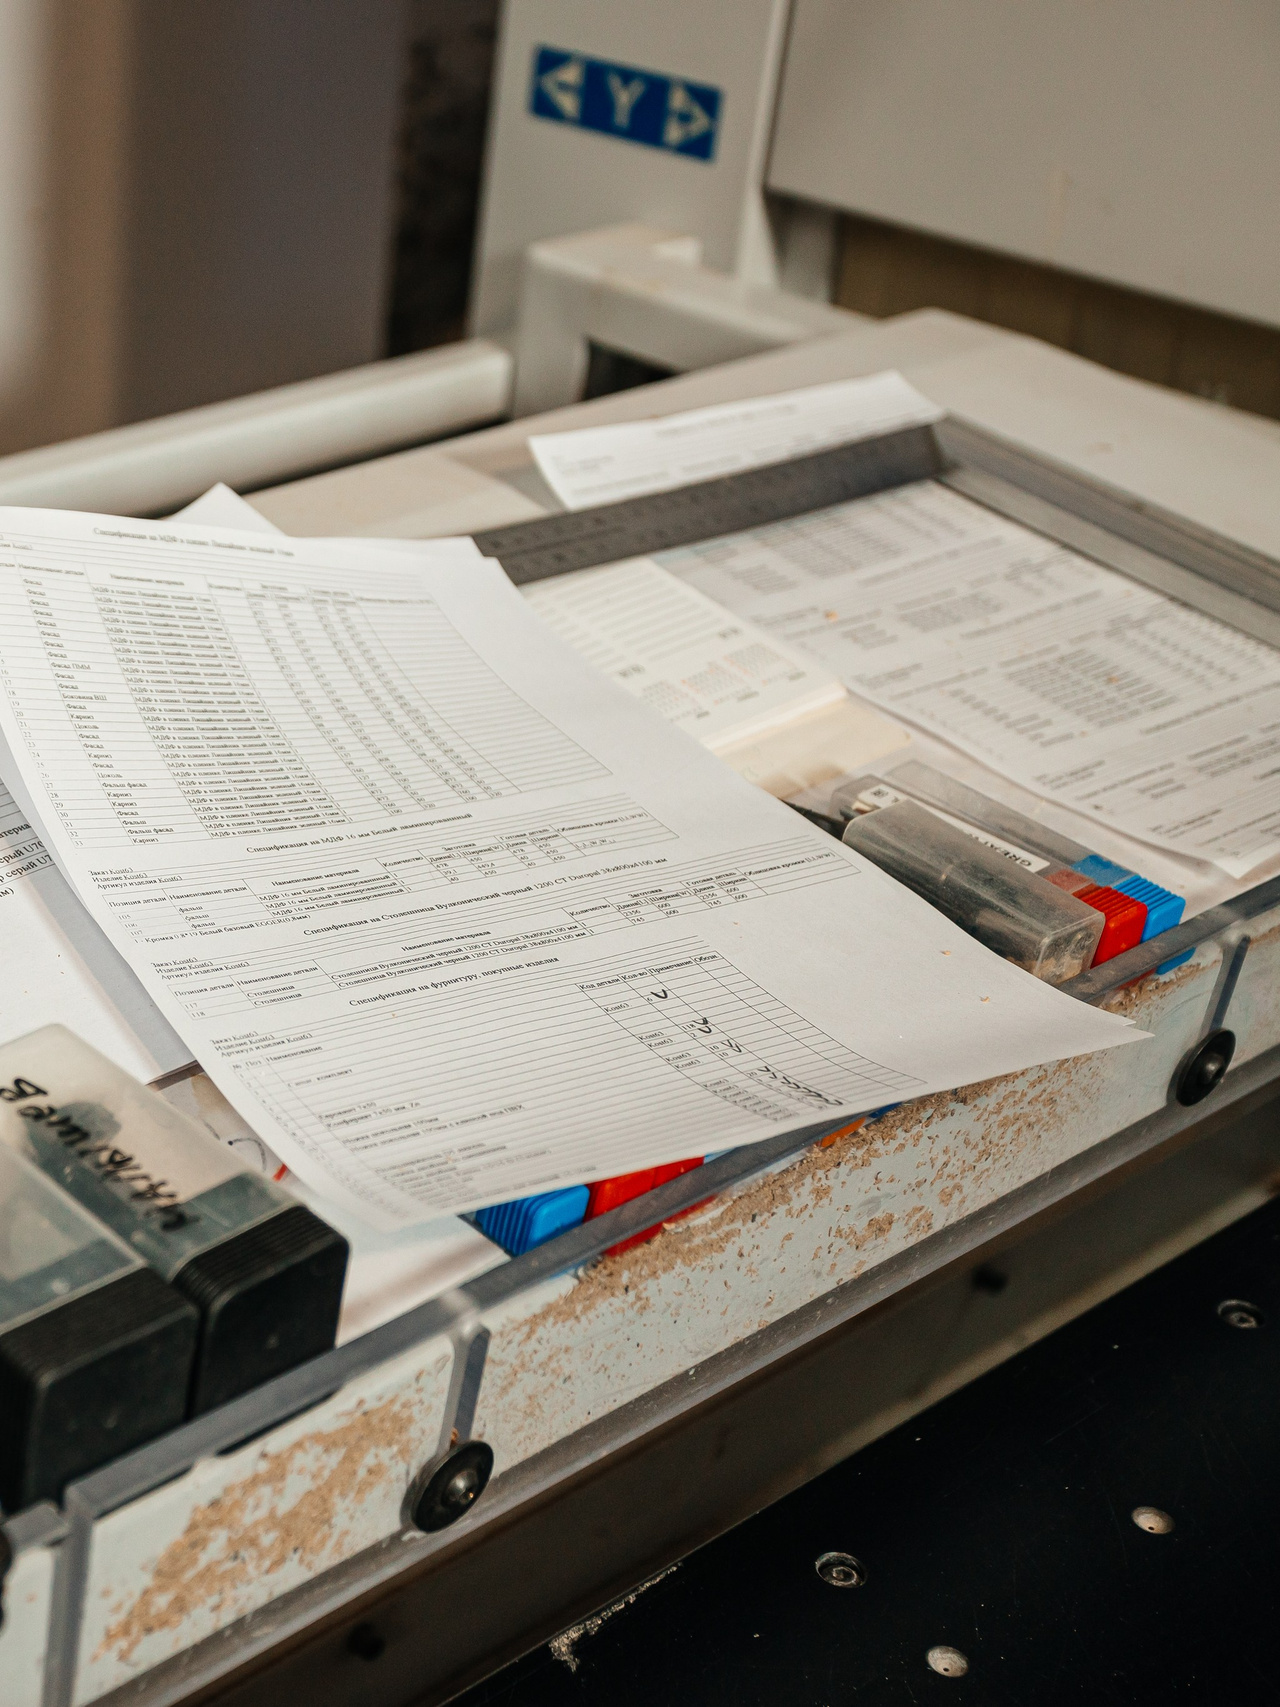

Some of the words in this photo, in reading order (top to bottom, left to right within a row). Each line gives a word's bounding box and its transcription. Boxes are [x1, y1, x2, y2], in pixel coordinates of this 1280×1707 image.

[607, 73, 645, 129] Y
[246, 841, 308, 854] Спецификация
[321, 835, 344, 844] МДФ
[371, 825, 398, 836] Белый
[5, 861, 38, 880] серый
[108, 899, 142, 908] Позиция
[169, 888, 222, 901] Наименование
[271, 873, 323, 887] Наименование
[303, 918, 369, 937] Спецификация
[370, 916, 381, 924] на
[381, 906, 436, 922] Столешница
[435, 891, 501, 910] Вулконический
[502, 884, 534, 896] черный
[533, 878, 554, 890] 1200
[569, 868, 601, 884] Duropal
[174, 987, 208, 997] Позиция
[236, 971, 292, 987] Наименование
[292, 965, 319, 976] детали
[401, 937, 454, 952] Наименование
[455, 930, 492, 942] материала
[569, 903, 611, 917] Количество
[247, 984, 296, 998] Столешница
[331, 965, 379, 981] Столешница
[436, 948, 463, 959] черный
[463, 943, 481, 953] 1200
[349, 986, 417, 1007] Спецификация
[418, 984, 429, 992] на
[430, 973, 482, 990] фурнитуру,
[481, 964, 524, 978] покупные
[525, 956, 560, 969] изделия
[579, 983, 596, 991] Код
[621, 971, 648, 982] Кол-во
[648, 958, 694, 975] Примечание
[254, 993, 303, 1006] Столешница
